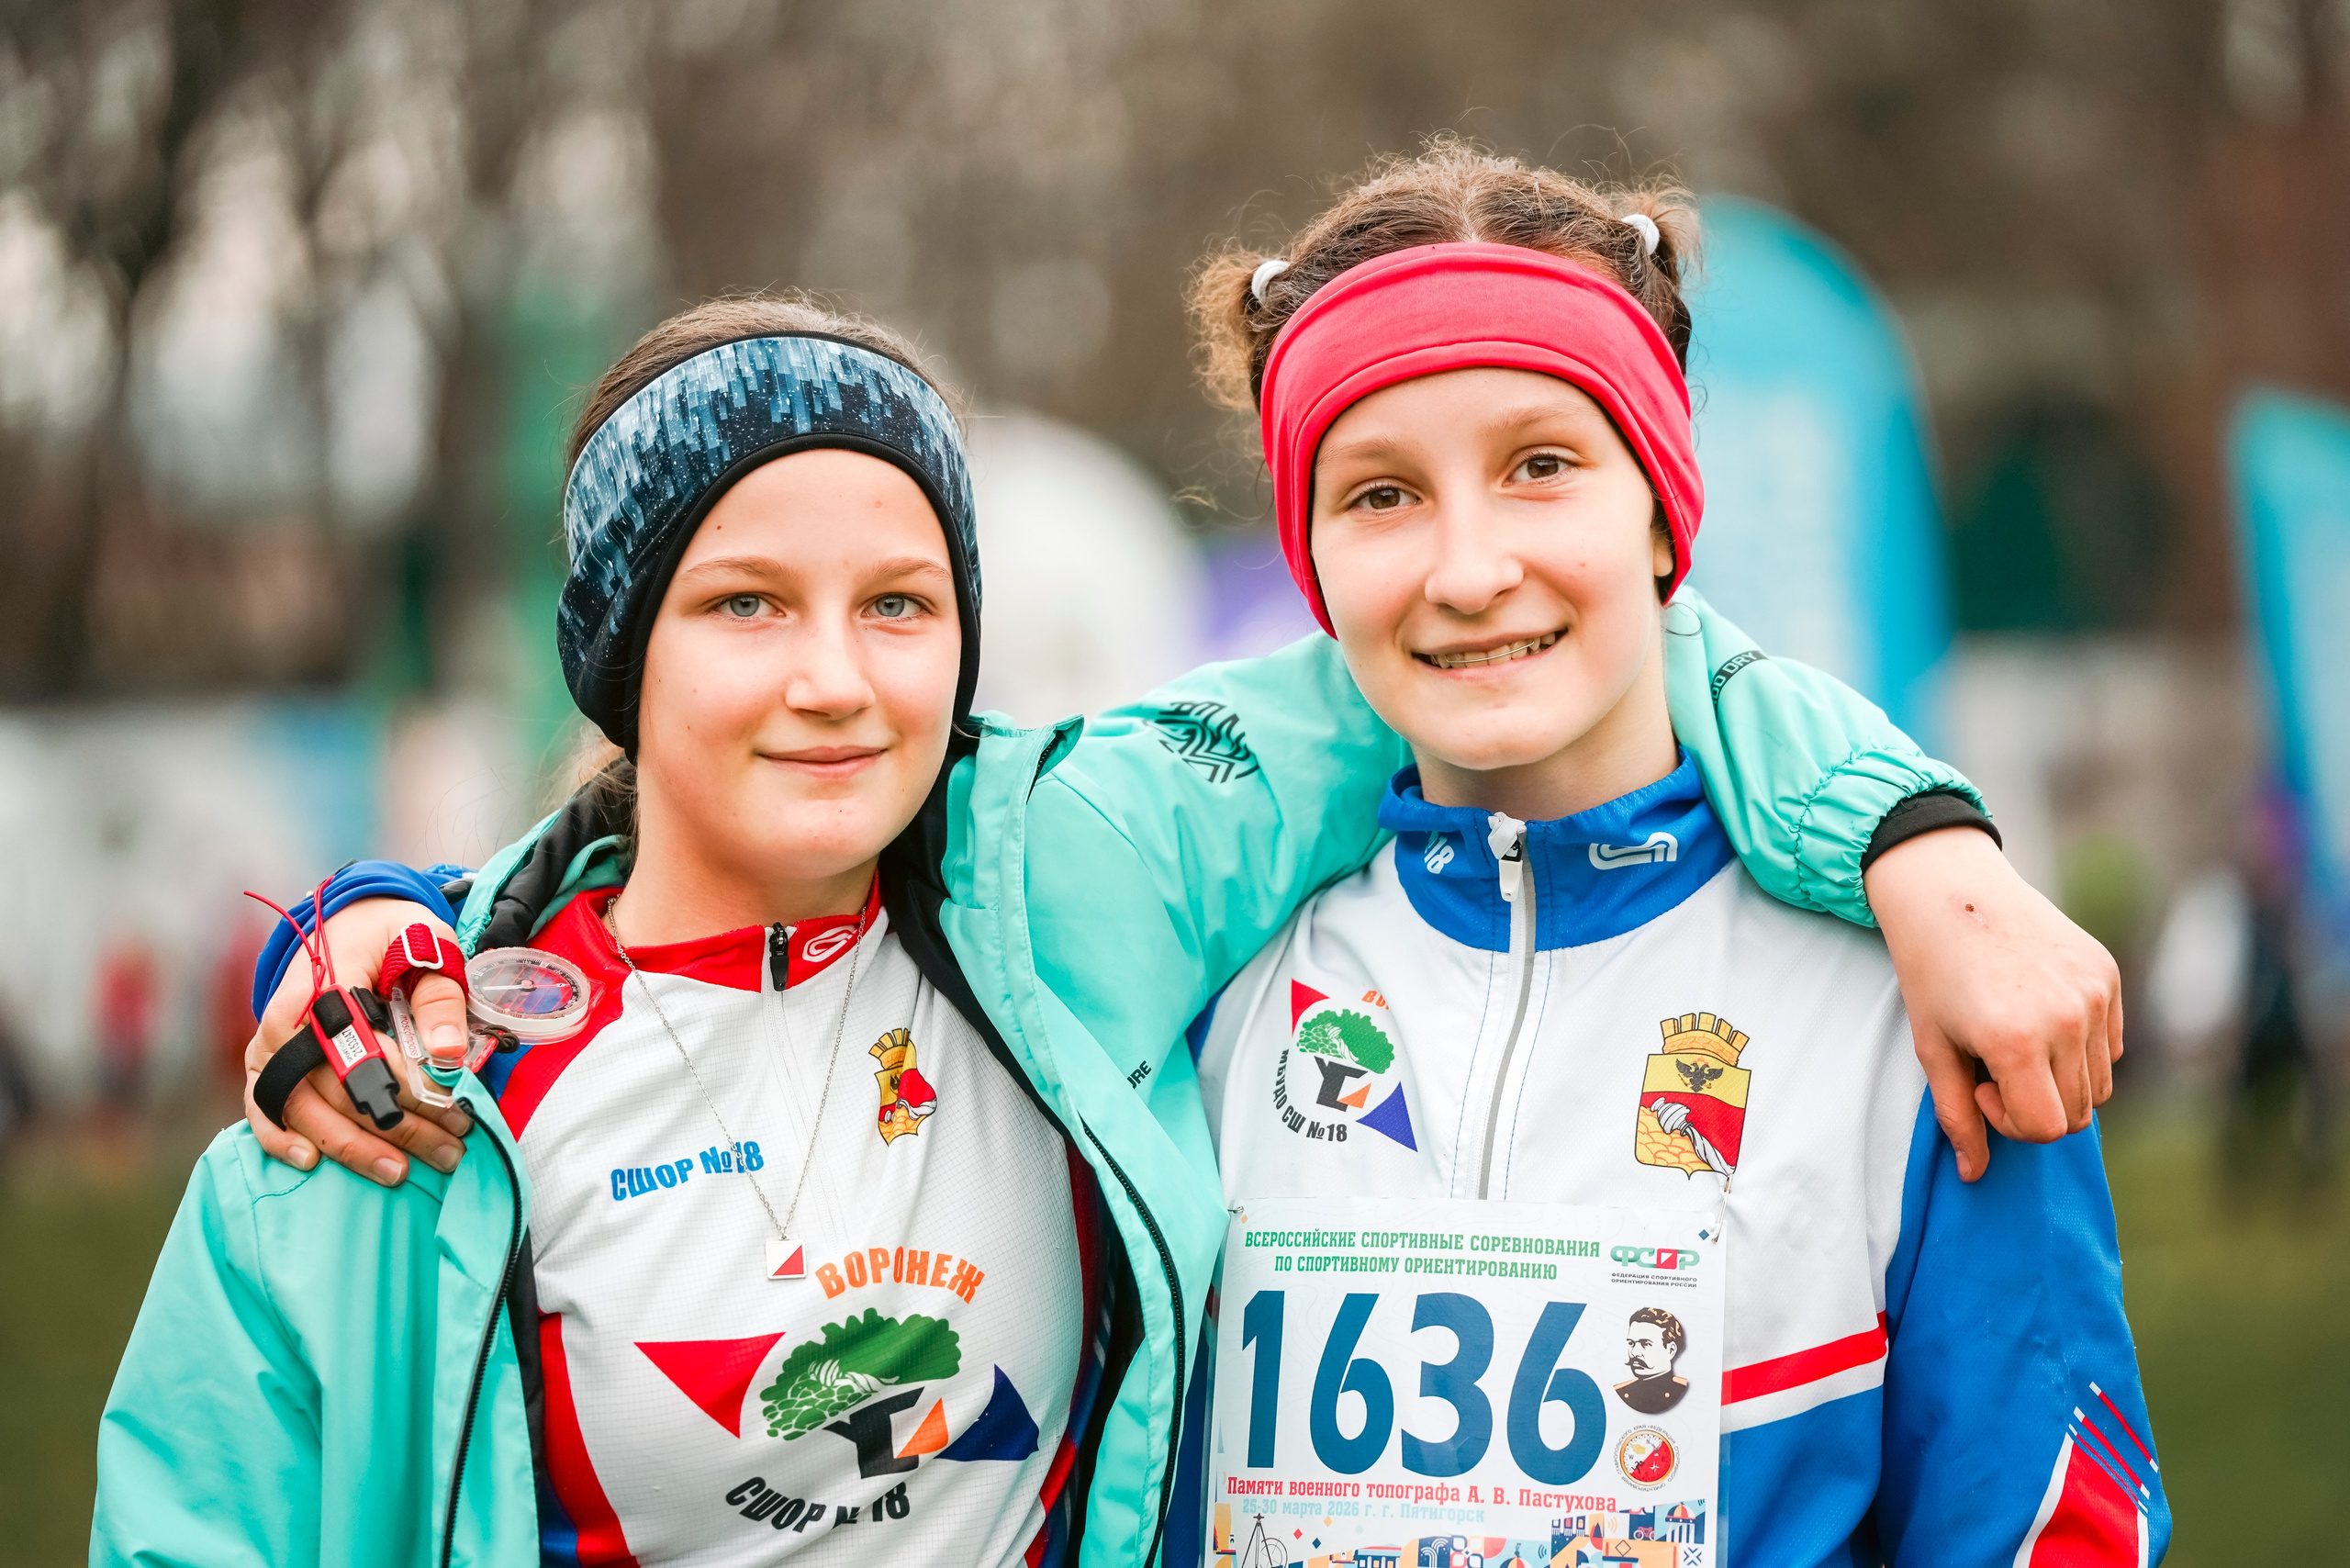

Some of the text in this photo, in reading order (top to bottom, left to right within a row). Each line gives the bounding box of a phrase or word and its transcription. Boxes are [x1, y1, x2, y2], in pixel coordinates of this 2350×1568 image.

[1722, 652, 1757, 674] DRY
[341, 1028, 364, 1058] 2153247
[1273, 1048, 1290, 1110] МБУДО
[1281, 1105, 1306, 1134] СШ
[610, 1159, 694, 1201] СШОР
[1245, 1228, 1600, 1258] ВСЕРОССИЙСКИЕ СПОРТИВНЫЕ СОРЕВНОВАНИЯ
[815, 1246, 985, 1305] ВОРОНЕЖ
[1274, 1255, 1558, 1280] ПО СПОРТИВНОМУ ОРИЕНТИРОВАНИЮ
[1611, 1278, 1669, 1286] ОРИЕНТИРОВАНИЯ
[1651, 1274, 1697, 1282] СПОРТИВНОГО
[1242, 1290, 1606, 1485] 1636
[725, 1476, 827, 1534] СШОР
[1227, 1476, 1617, 1513] Памяти военного топографа А. В. Пастухова
[1242, 1497, 1485, 1526] 25-30 марта 2026 г. г. Пятигорск
